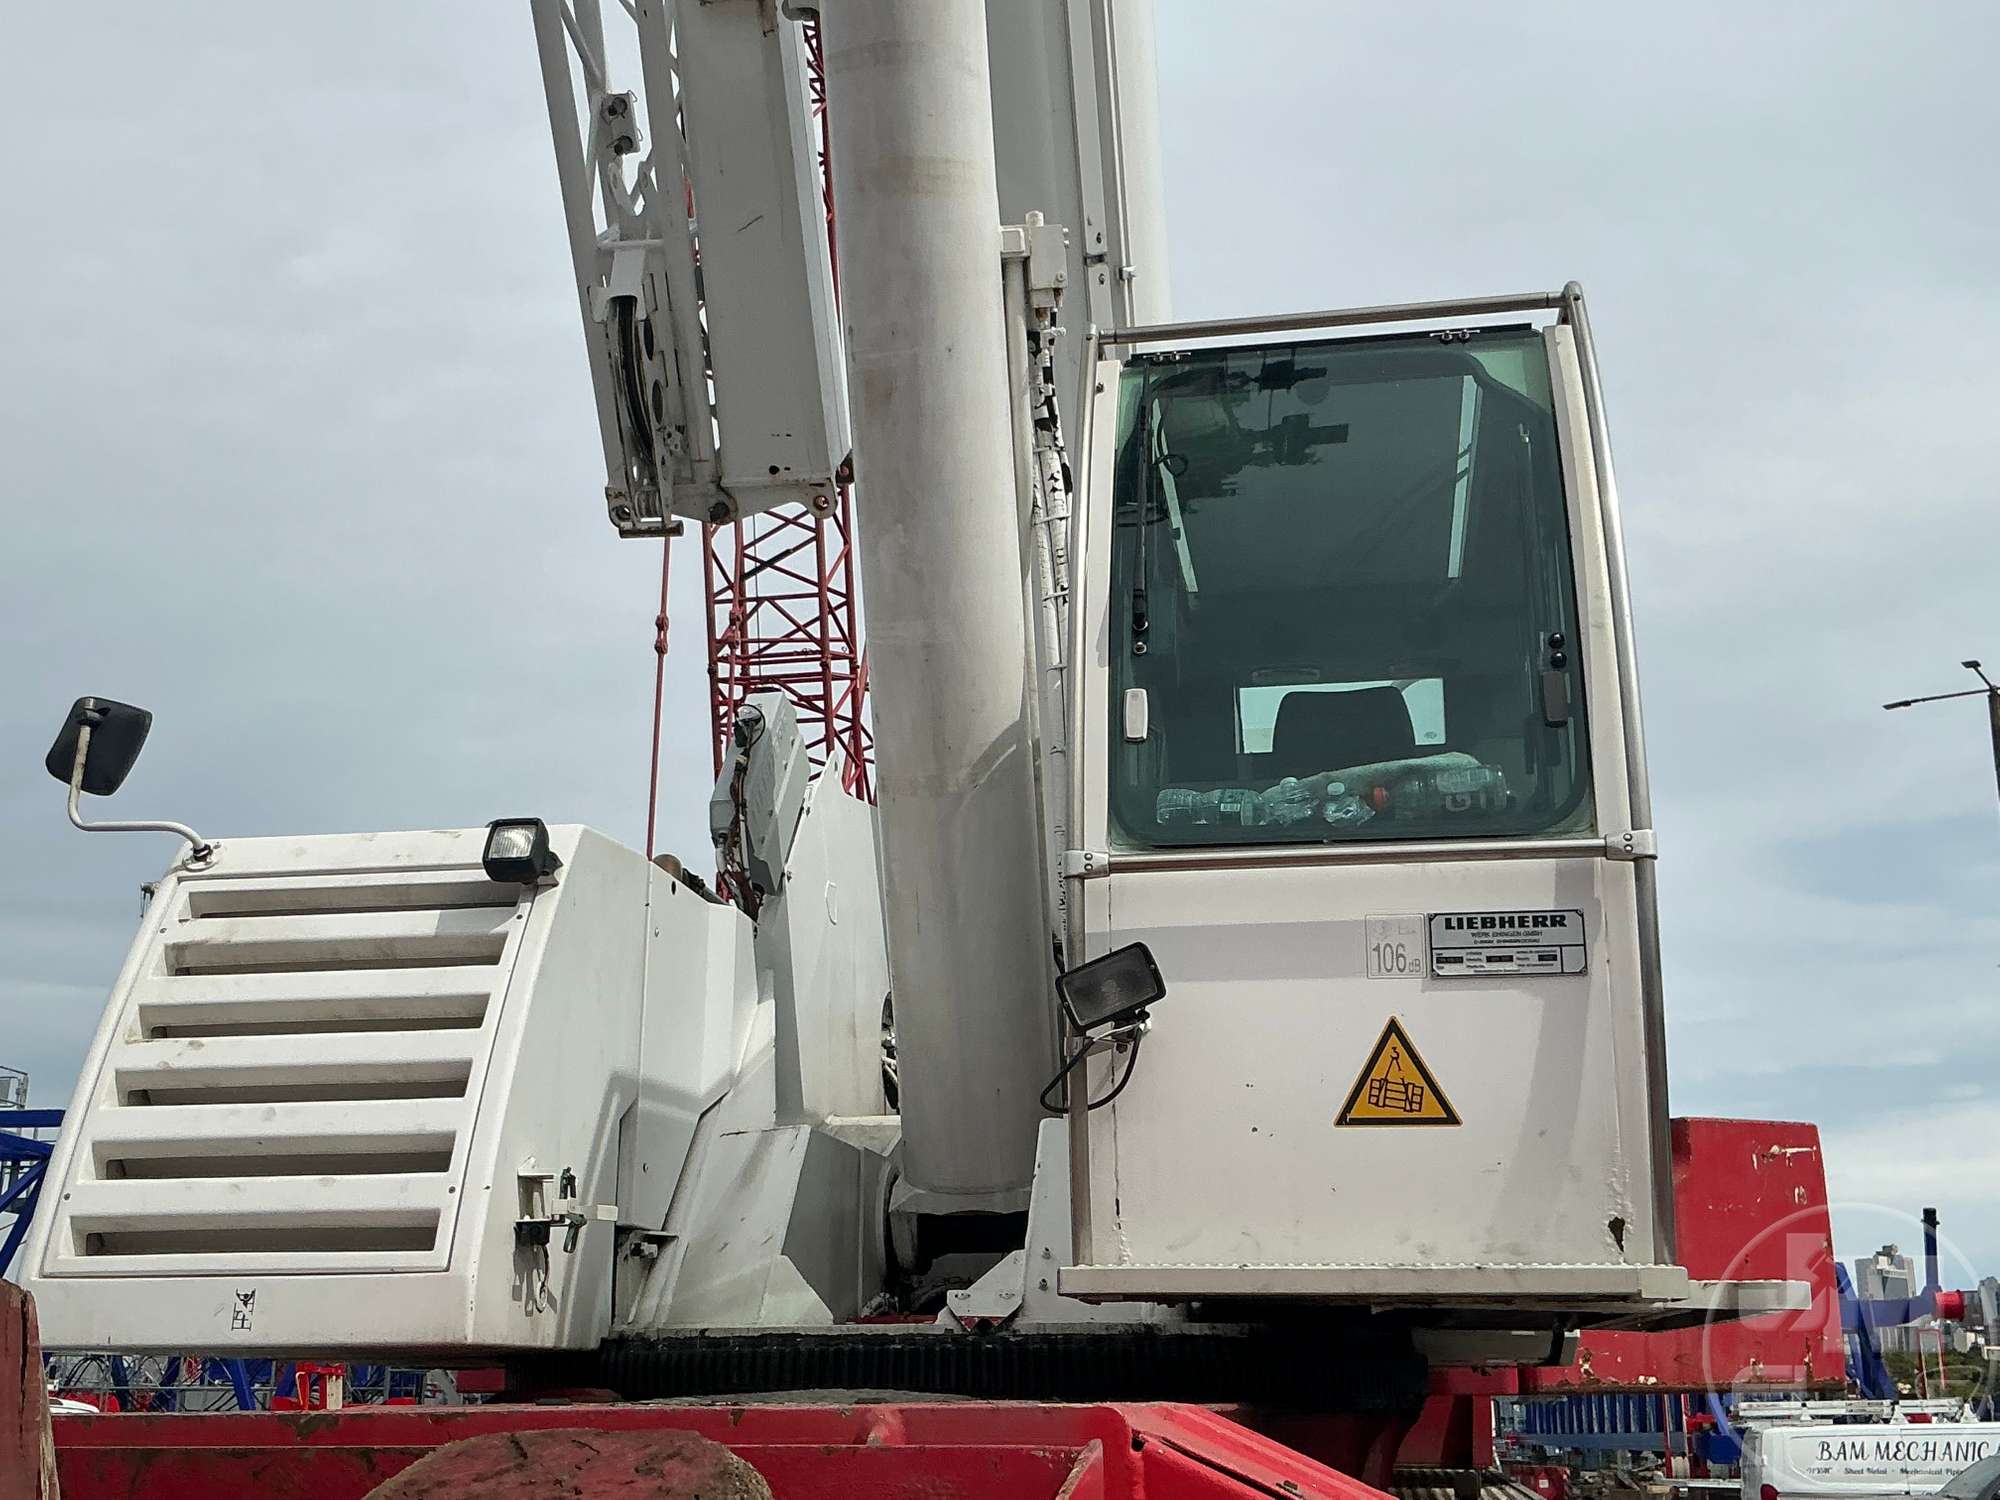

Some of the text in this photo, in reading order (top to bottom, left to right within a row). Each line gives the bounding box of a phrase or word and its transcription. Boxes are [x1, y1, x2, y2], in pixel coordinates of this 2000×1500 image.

[1445, 915, 1567, 930] LIEBHERR
[1817, 1440, 2000, 1461] BAM MECHANIC
